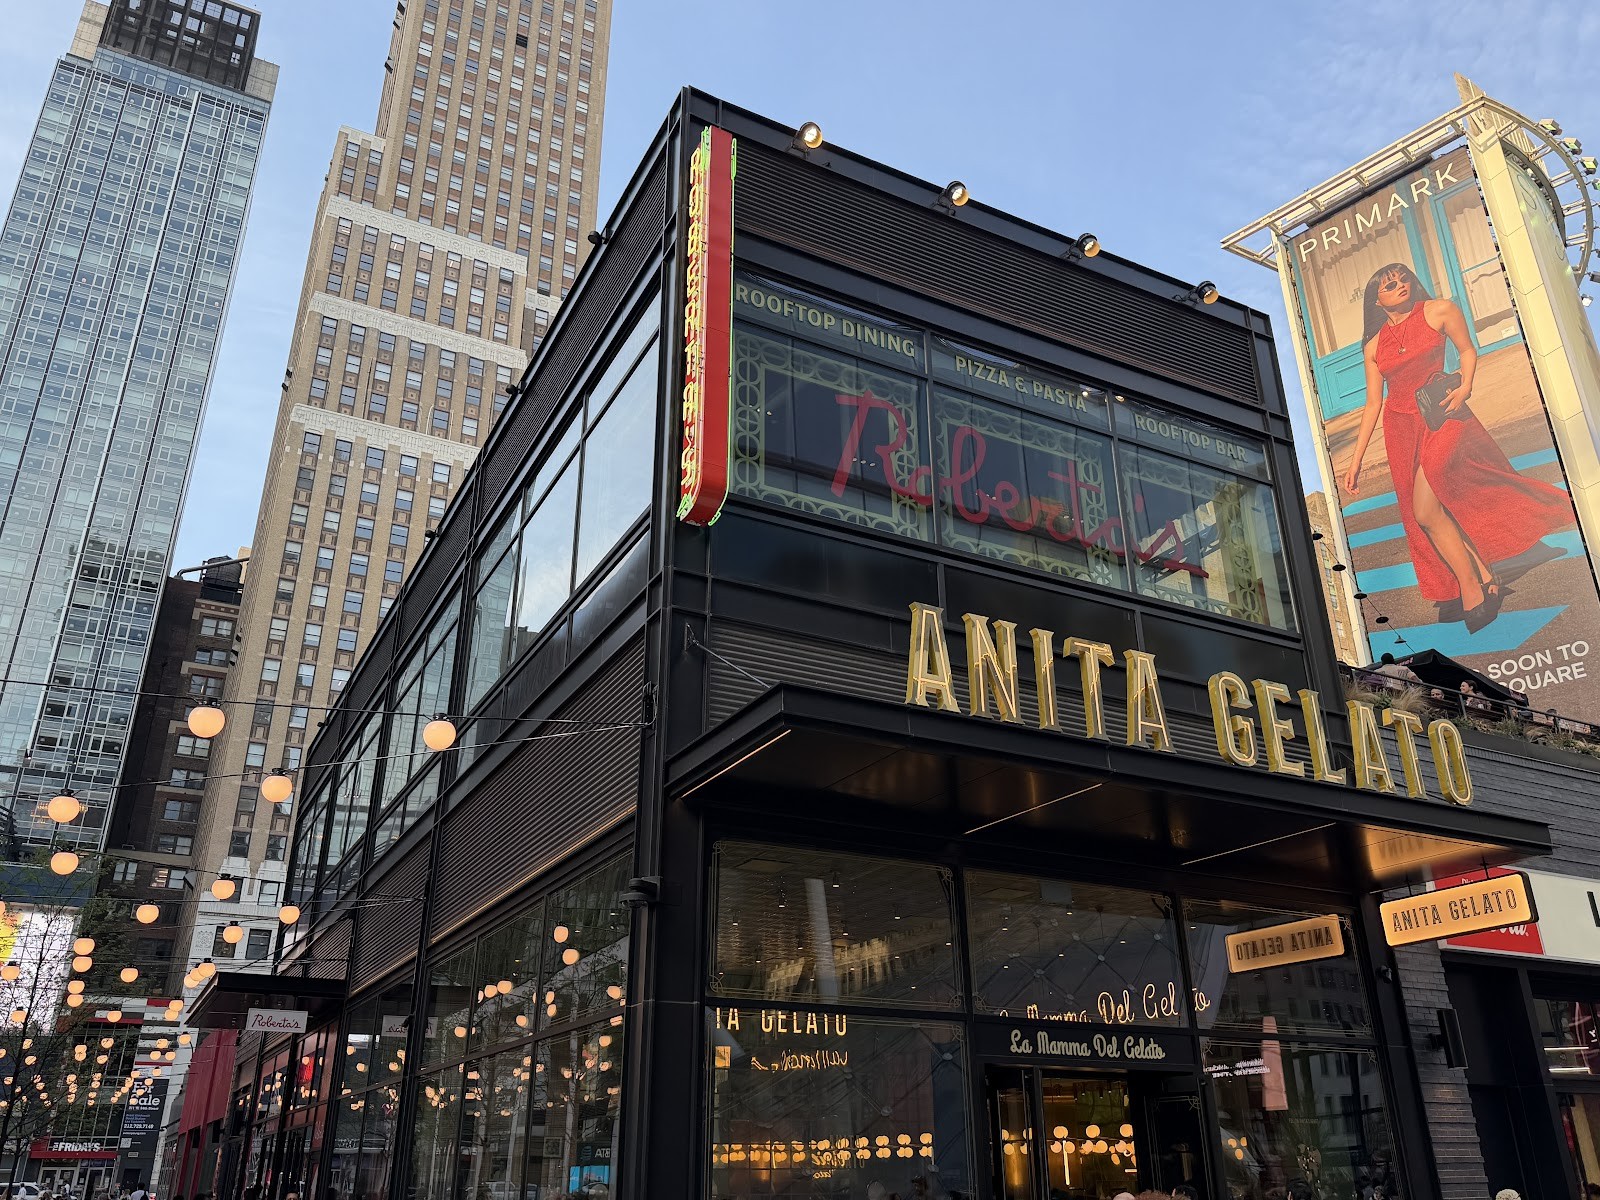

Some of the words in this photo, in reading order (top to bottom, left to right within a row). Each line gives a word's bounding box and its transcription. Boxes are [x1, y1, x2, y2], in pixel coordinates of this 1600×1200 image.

[1299, 162, 1458, 262] PRIMARK
[735, 282, 836, 331] ROOFTOP
[841, 317, 916, 358] DINING
[954, 354, 1010, 389] PIZZA
[1015, 374, 1029, 394] &
[1032, 380, 1088, 413] PASTA
[1134, 411, 1212, 450] ROOFTOP
[1215, 439, 1249, 464] BAR
[830, 389, 1209, 579] Roberta's
[1487, 649, 1553, 679] SOON
[1556, 640, 1589, 660] TO
[905, 601, 1177, 754] ANITA
[1208, 671, 1474, 806] GELATO
[1392, 904, 1442, 933] ANITA
[1449, 888, 1517, 921] GELATO
[251, 1013, 302, 1029] Roberta's
[1010, 1029, 1033, 1054] La
[1037, 1031, 1091, 1056] Mamma
[1093, 1034, 1120, 1058] Del
[1124, 1035, 1165, 1059] Gelato
